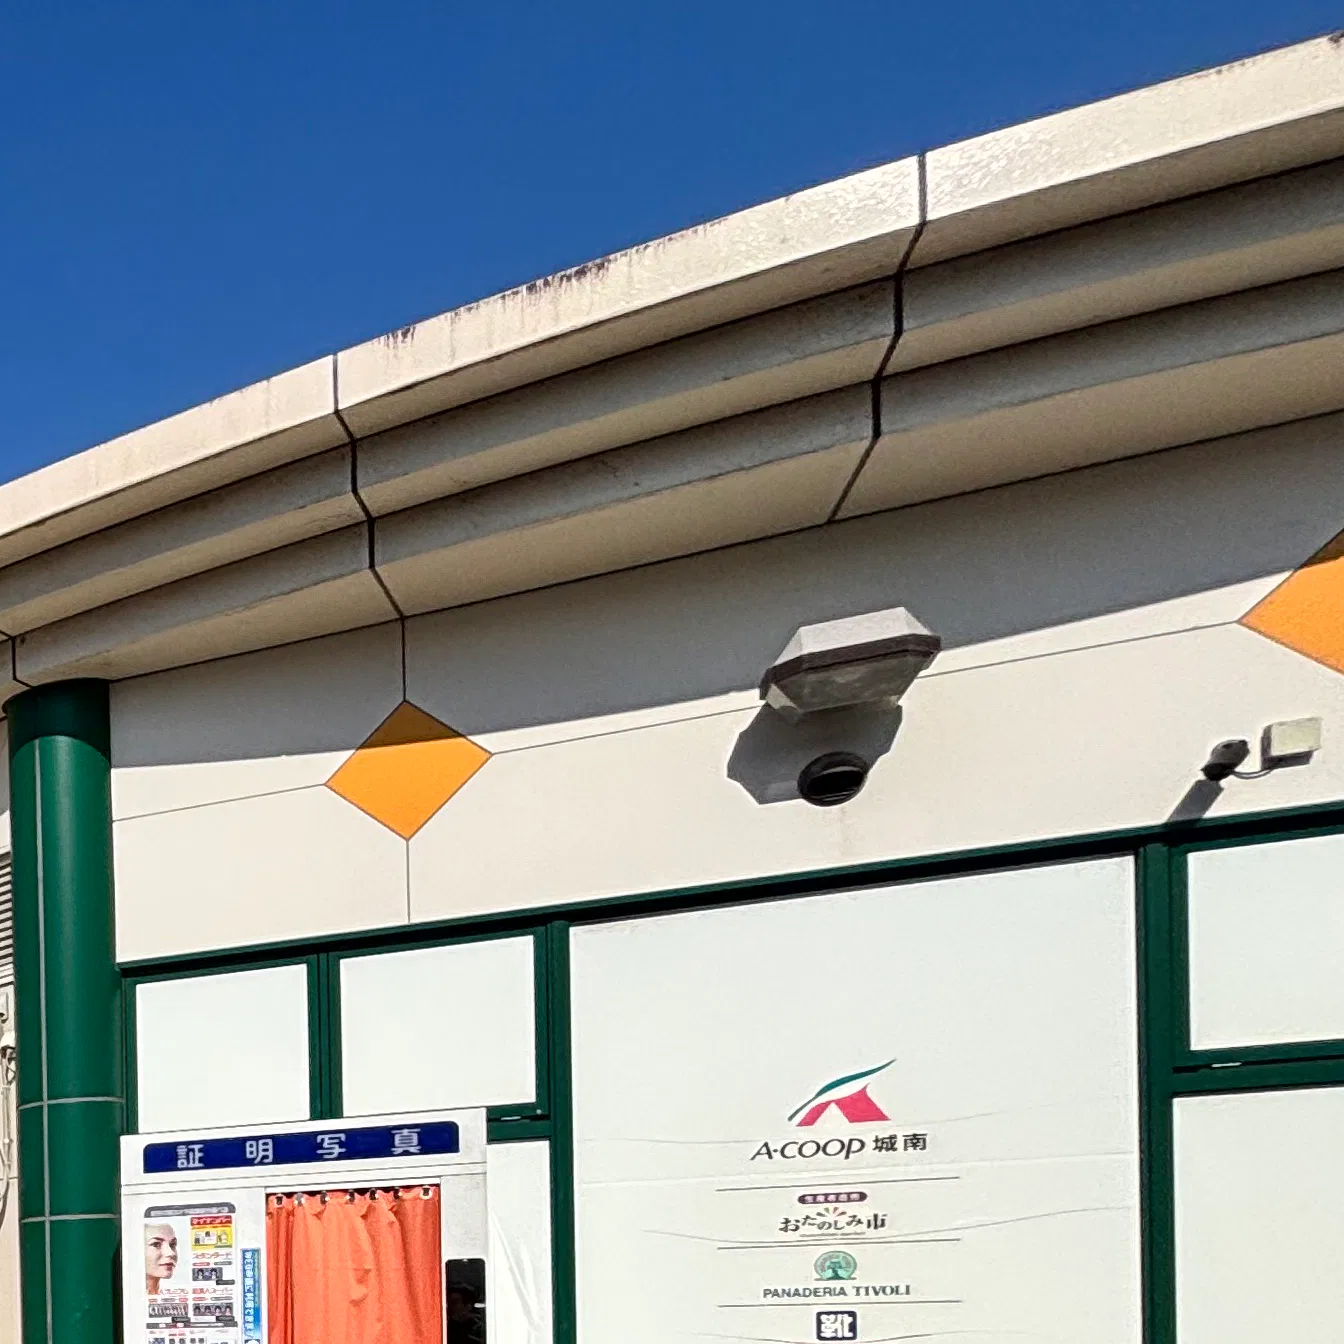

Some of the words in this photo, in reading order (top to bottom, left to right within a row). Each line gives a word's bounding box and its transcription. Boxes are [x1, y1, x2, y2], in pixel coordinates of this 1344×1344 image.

[176, 1128, 421, 1169] 証明写真
[872, 1133, 928, 1152] 城南
[762, 1286, 848, 1299] PANADERIA
[852, 1284, 911, 1297] TIVOLI
